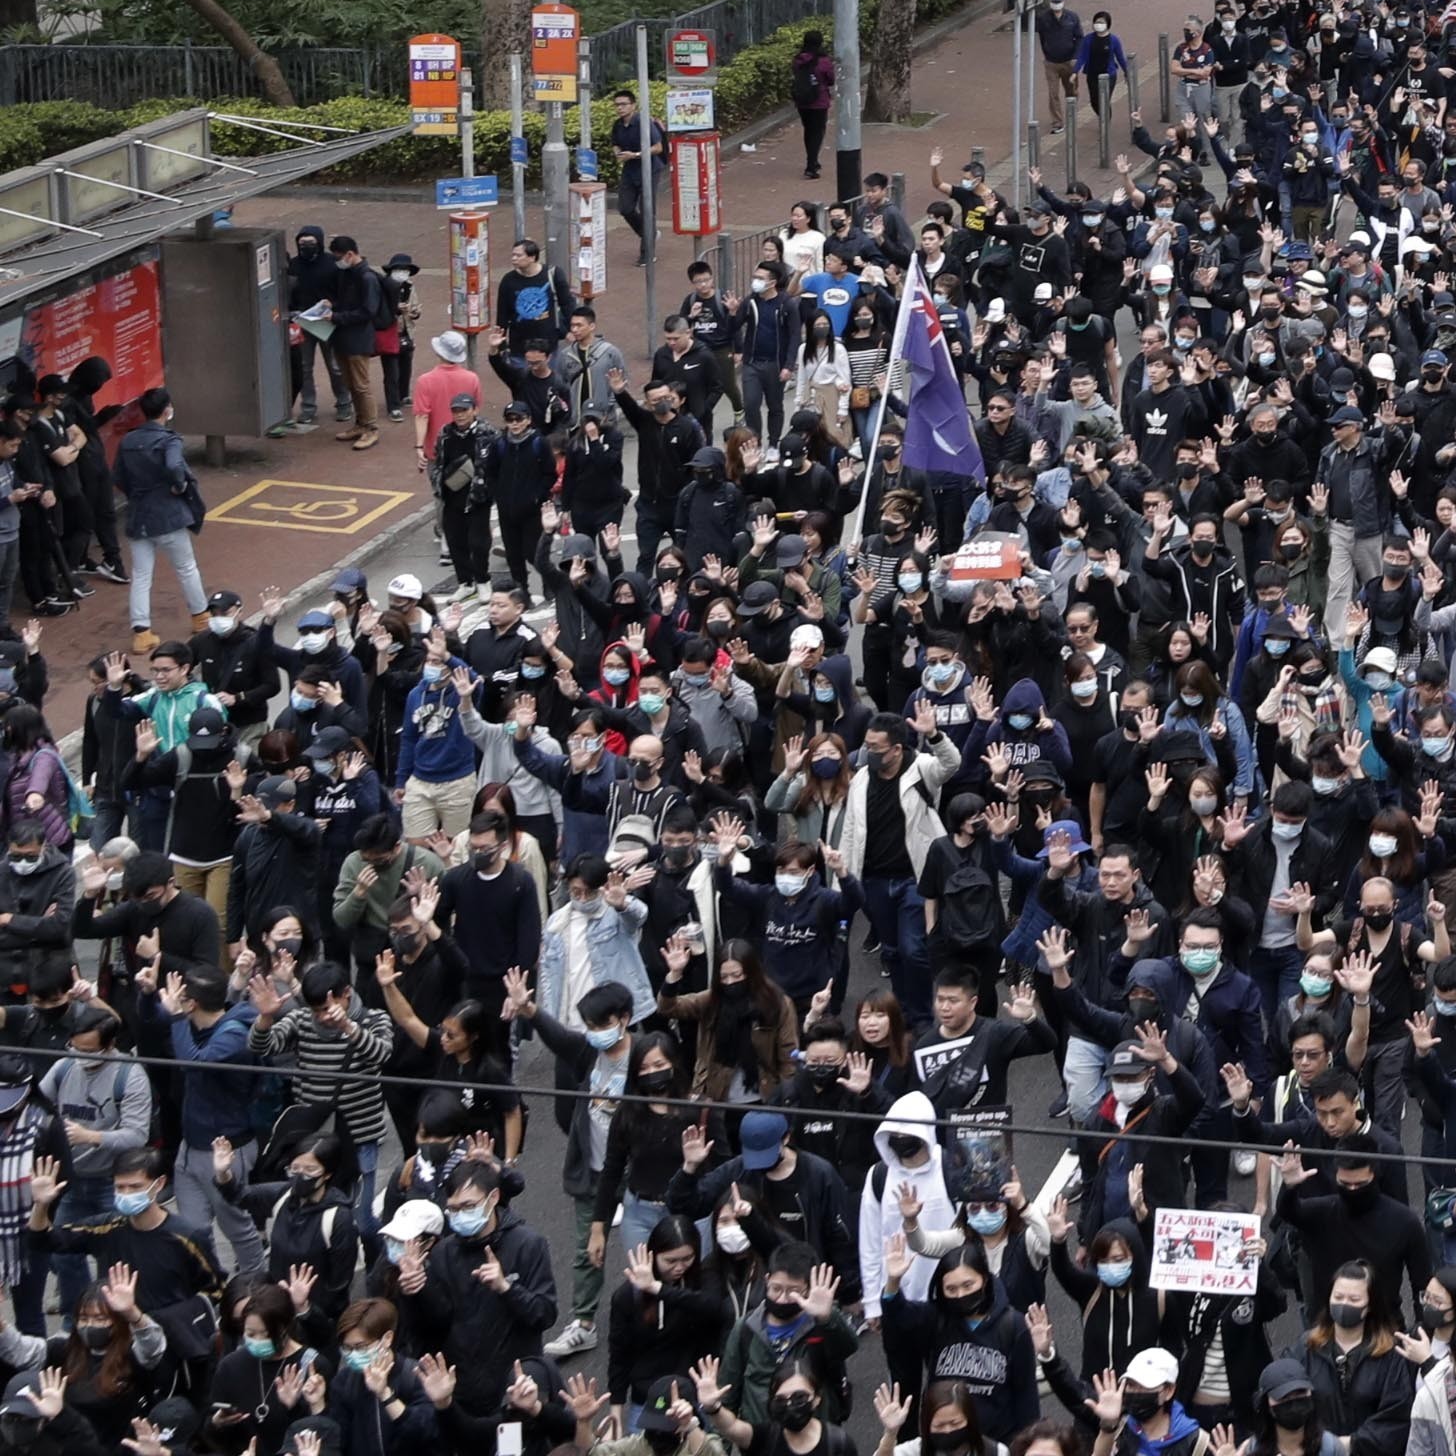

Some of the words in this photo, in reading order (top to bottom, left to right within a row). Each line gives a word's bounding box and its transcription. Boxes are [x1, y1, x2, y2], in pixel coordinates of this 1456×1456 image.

[950, 1113, 975, 1123] Never
[976, 1111, 994, 1123] give
[1160, 1213, 1217, 1228] 五大訴求
[1201, 1273, 1253, 1290] 香港人
